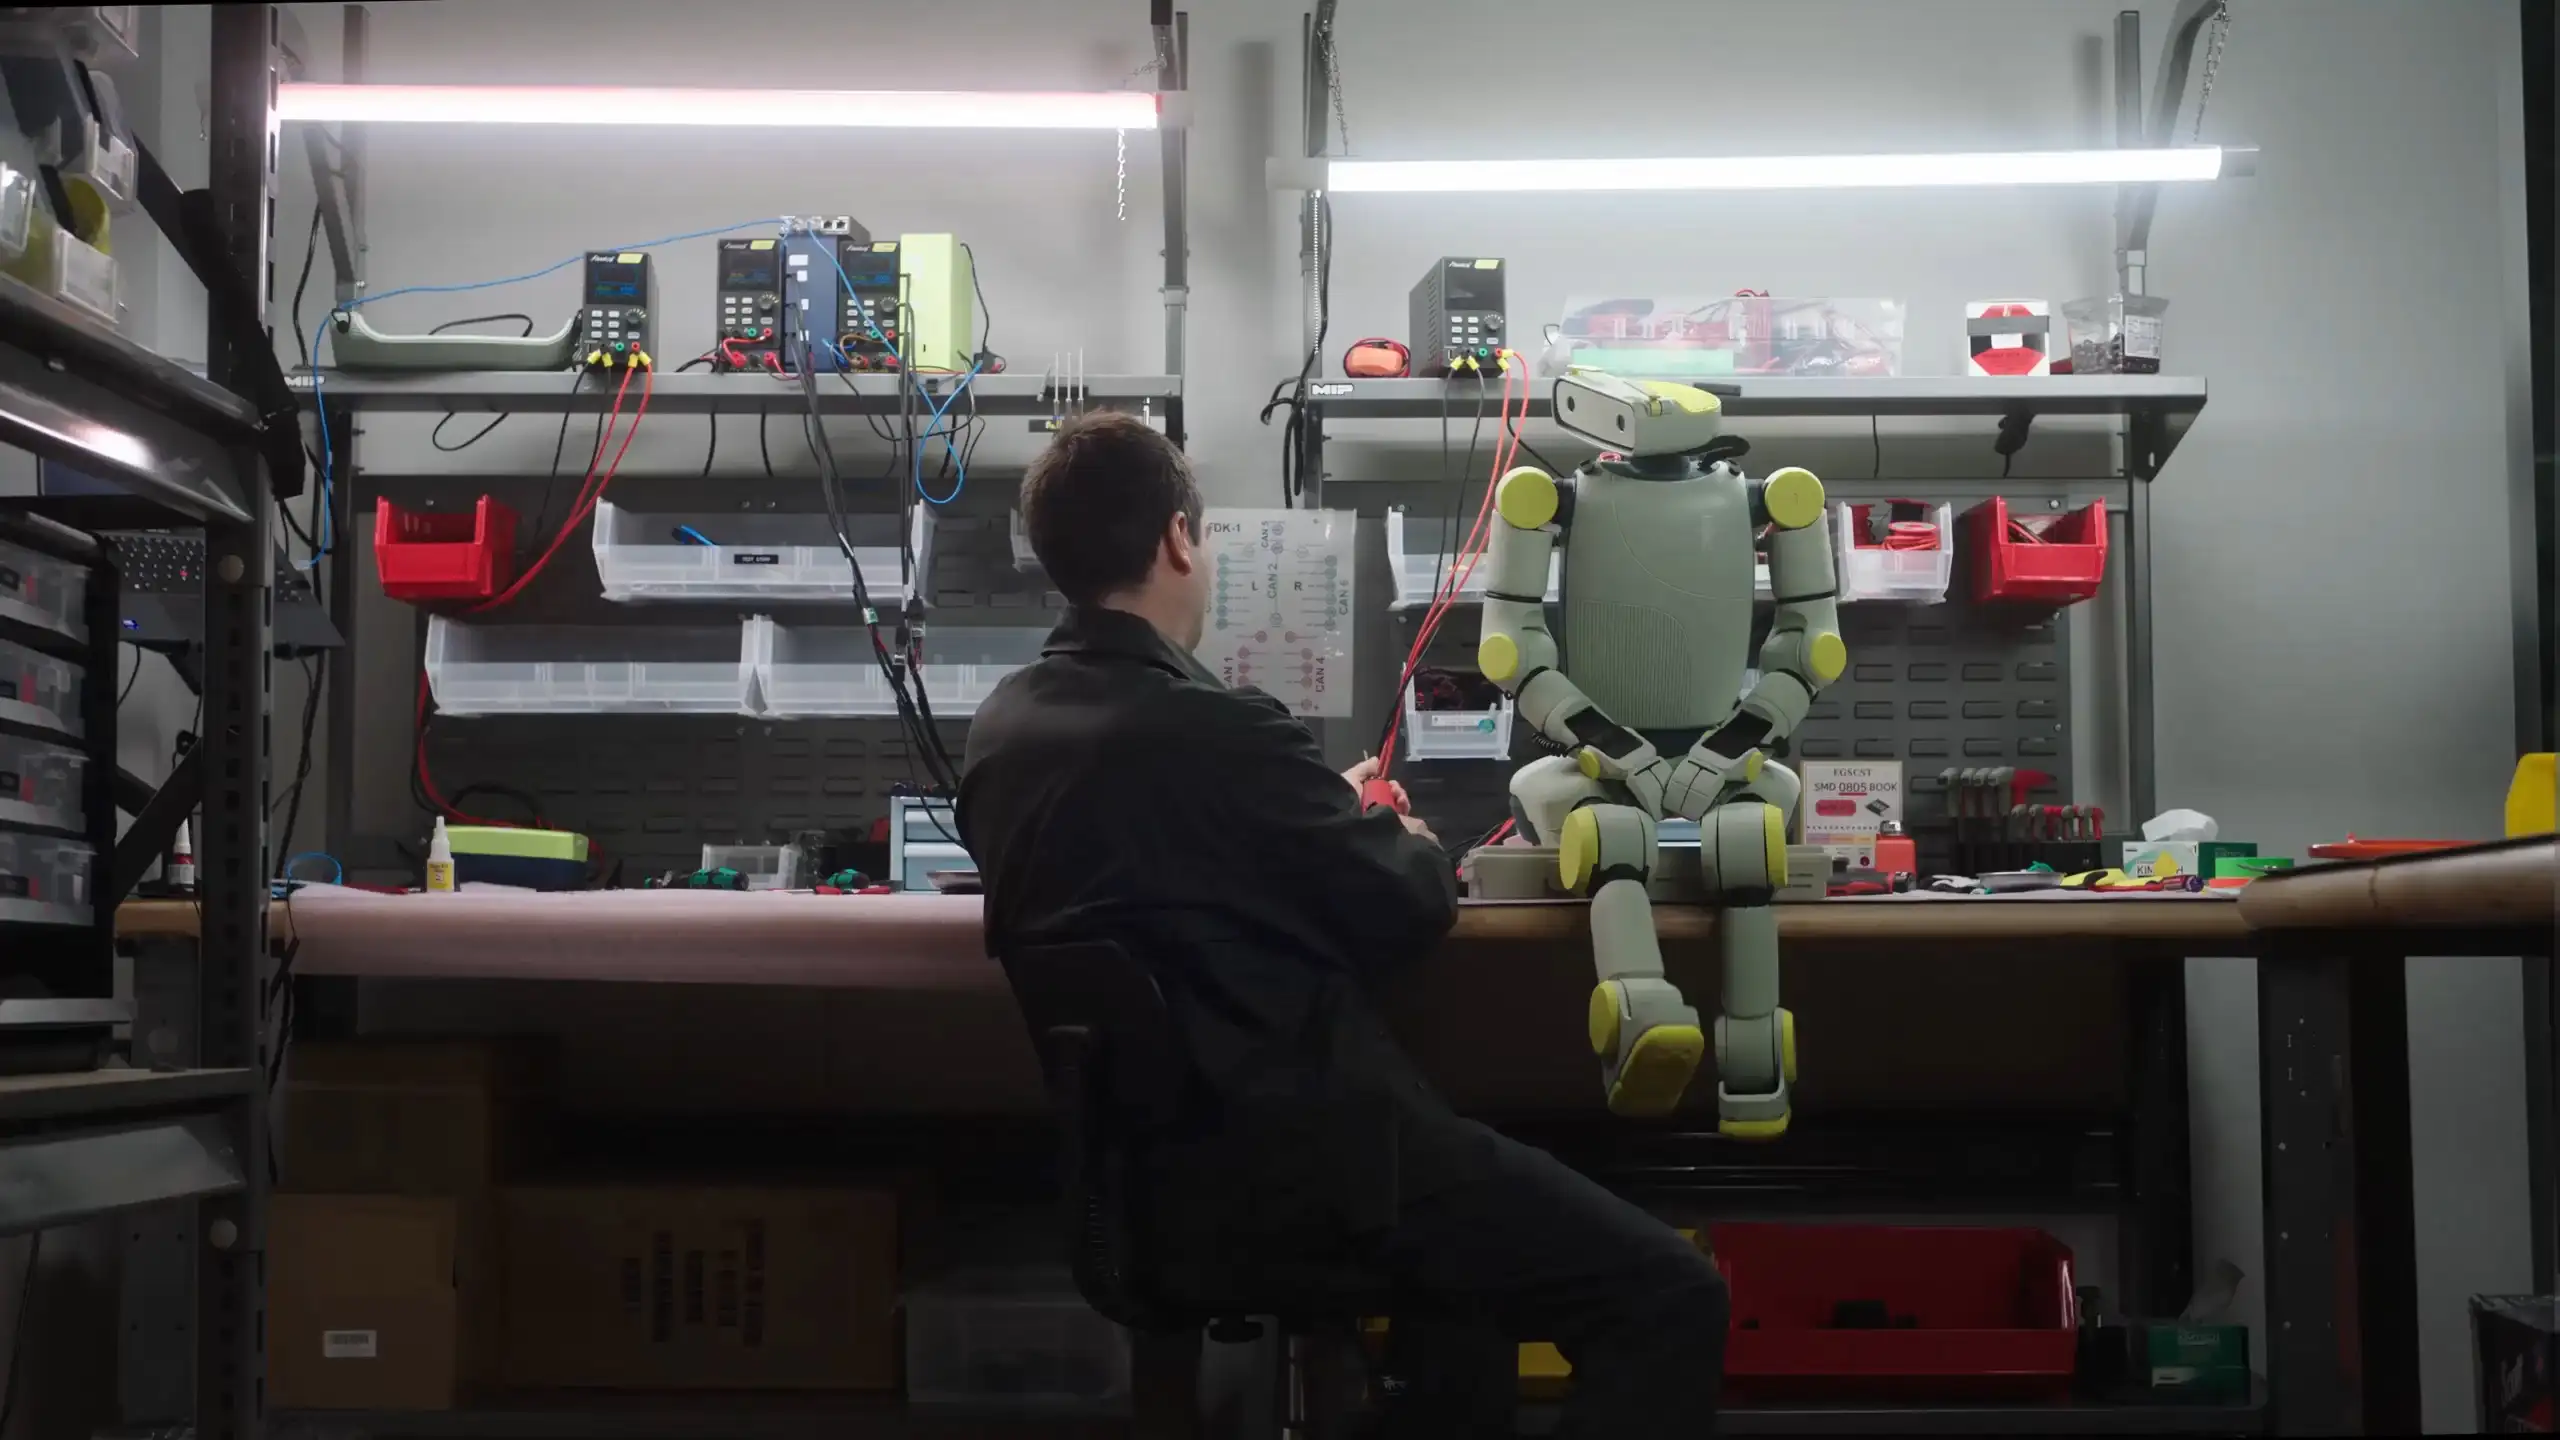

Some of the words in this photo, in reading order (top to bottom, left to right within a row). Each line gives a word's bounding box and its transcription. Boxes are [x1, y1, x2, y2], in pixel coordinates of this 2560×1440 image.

[1311, 383, 1355, 395] MIP
[1261, 528, 1269, 548] CAN
[1268, 562, 1278, 570] 2
[1251, 580, 1259, 591] L
[1267, 573, 1278, 599] CAN
[1294, 580, 1303, 591] R
[1339, 590, 1349, 615] CAN
[1316, 656, 1326, 665] 4
[1316, 667, 1326, 693] CAN
[1814, 782, 1836, 792] SMD
[1838, 782, 1867, 792] 0805
[1869, 782, 1898, 792] BOOK
